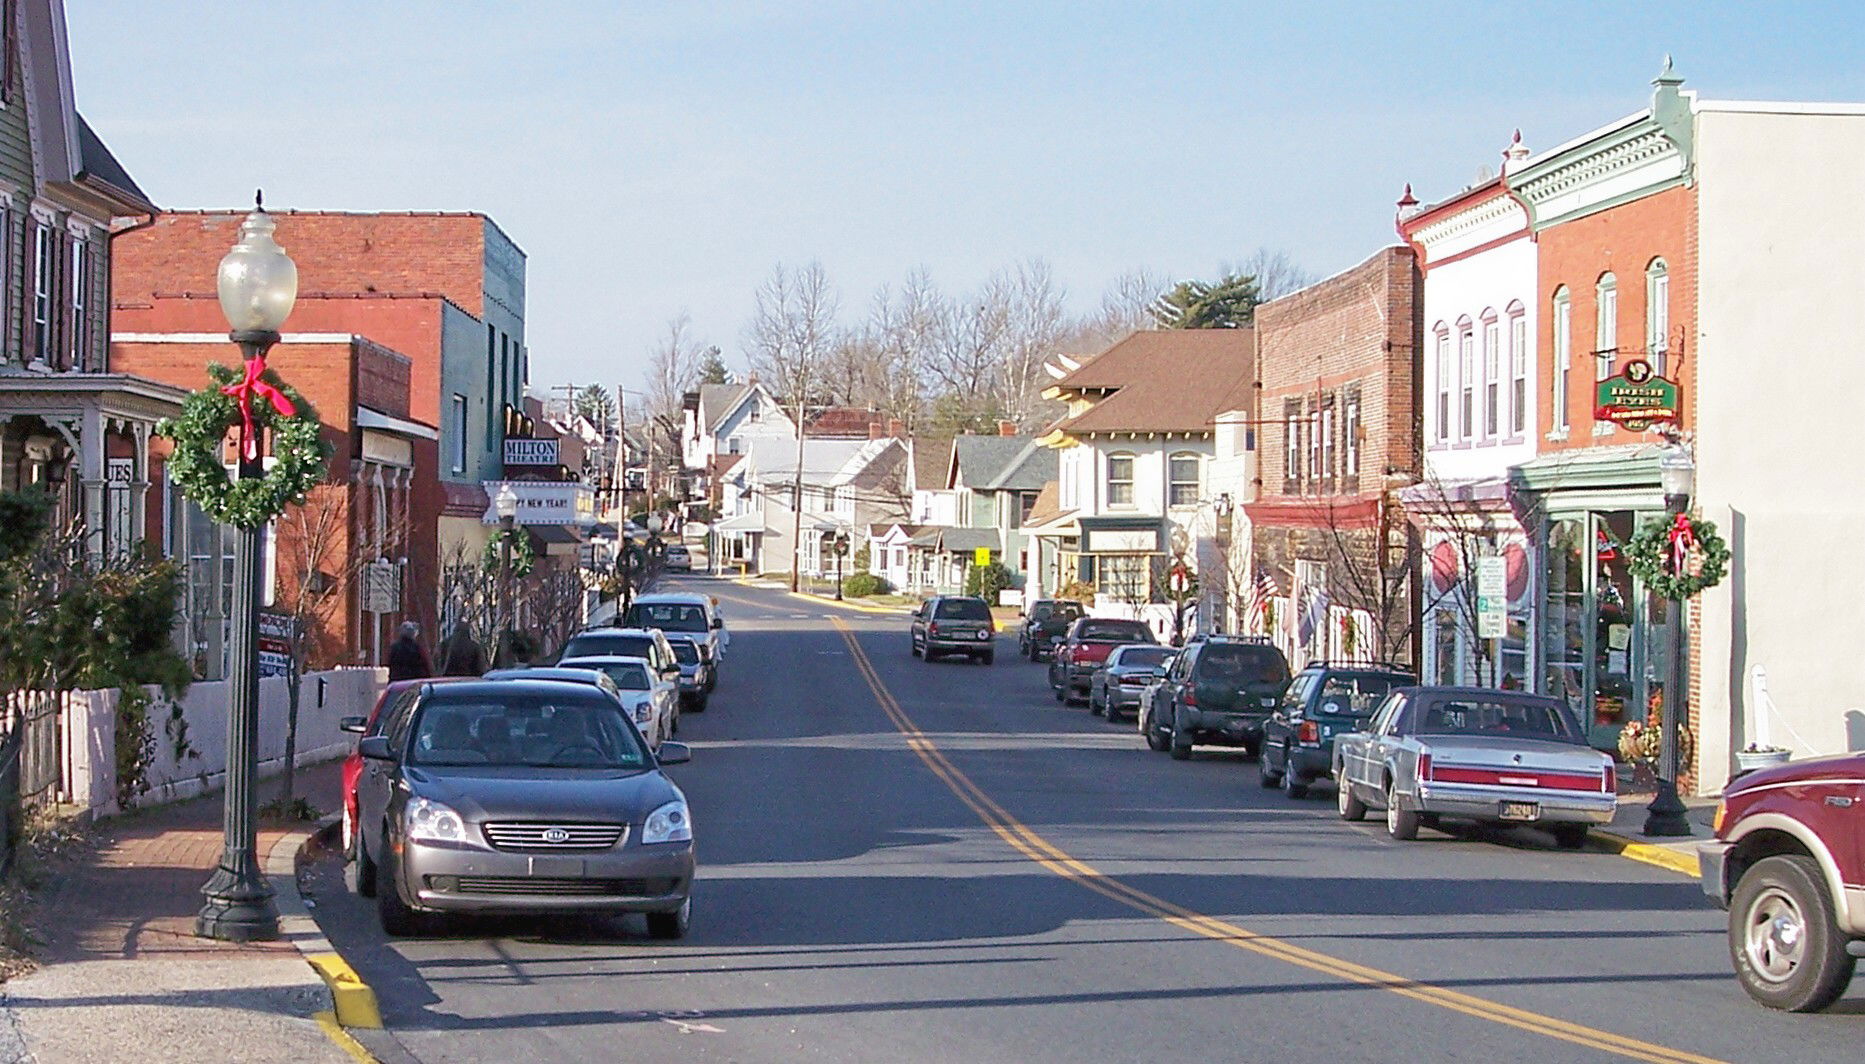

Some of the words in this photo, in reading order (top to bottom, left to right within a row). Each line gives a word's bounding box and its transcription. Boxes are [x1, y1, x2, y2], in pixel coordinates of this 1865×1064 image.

[506, 441, 555, 455] MILTON
[506, 455, 555, 463] THEATRE
[528, 498, 543, 508] NEW
[546, 830, 567, 841] KIA
